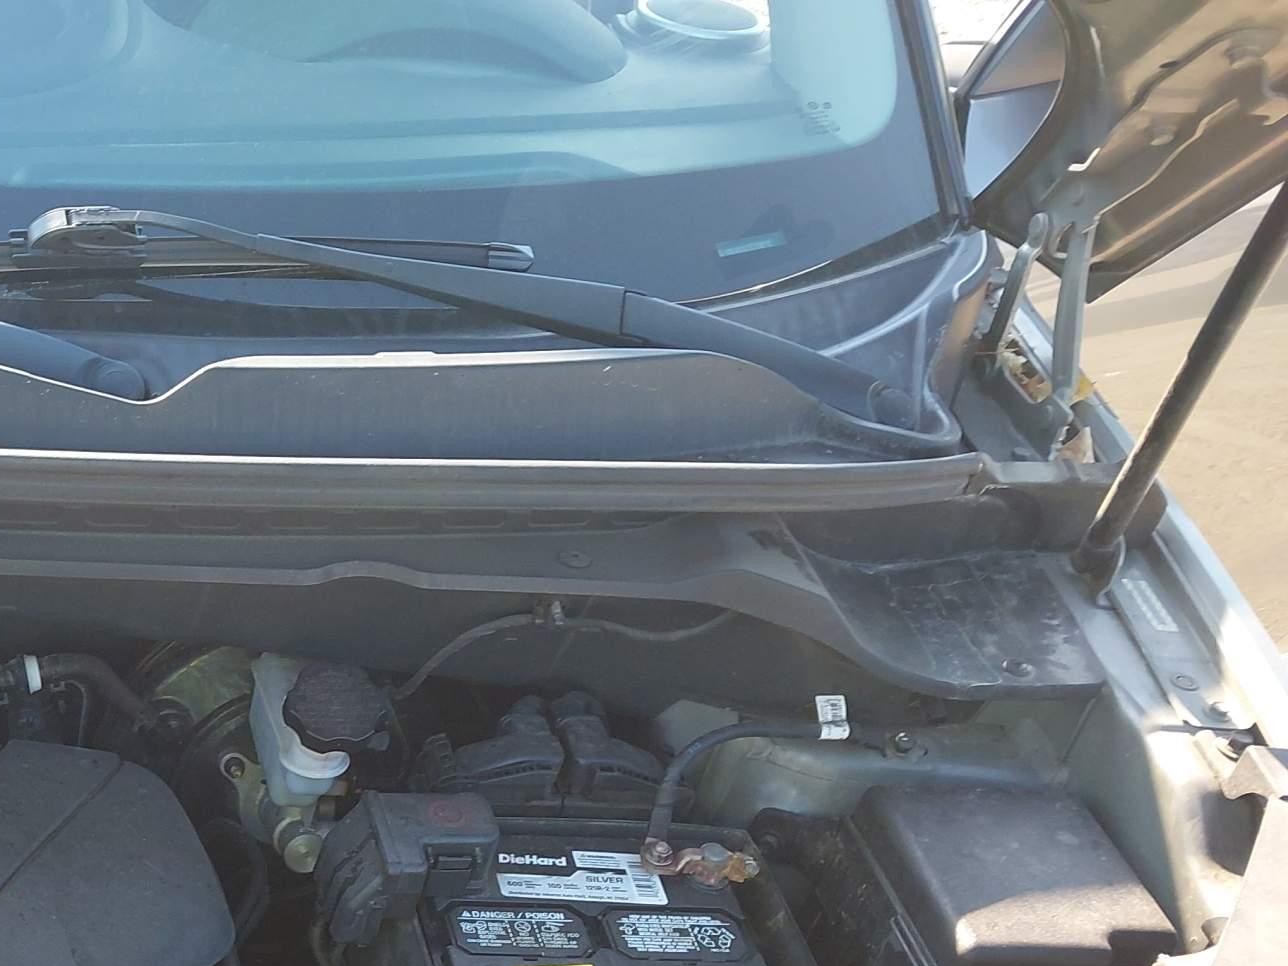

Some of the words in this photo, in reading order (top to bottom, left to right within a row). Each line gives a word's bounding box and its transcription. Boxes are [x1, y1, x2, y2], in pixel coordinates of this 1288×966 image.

[498, 853, 567, 867] DieHard
[585, 874, 624, 884] SILVER
[472, 911, 515, 919] DANGER
[525, 912, 565, 920] POISON
